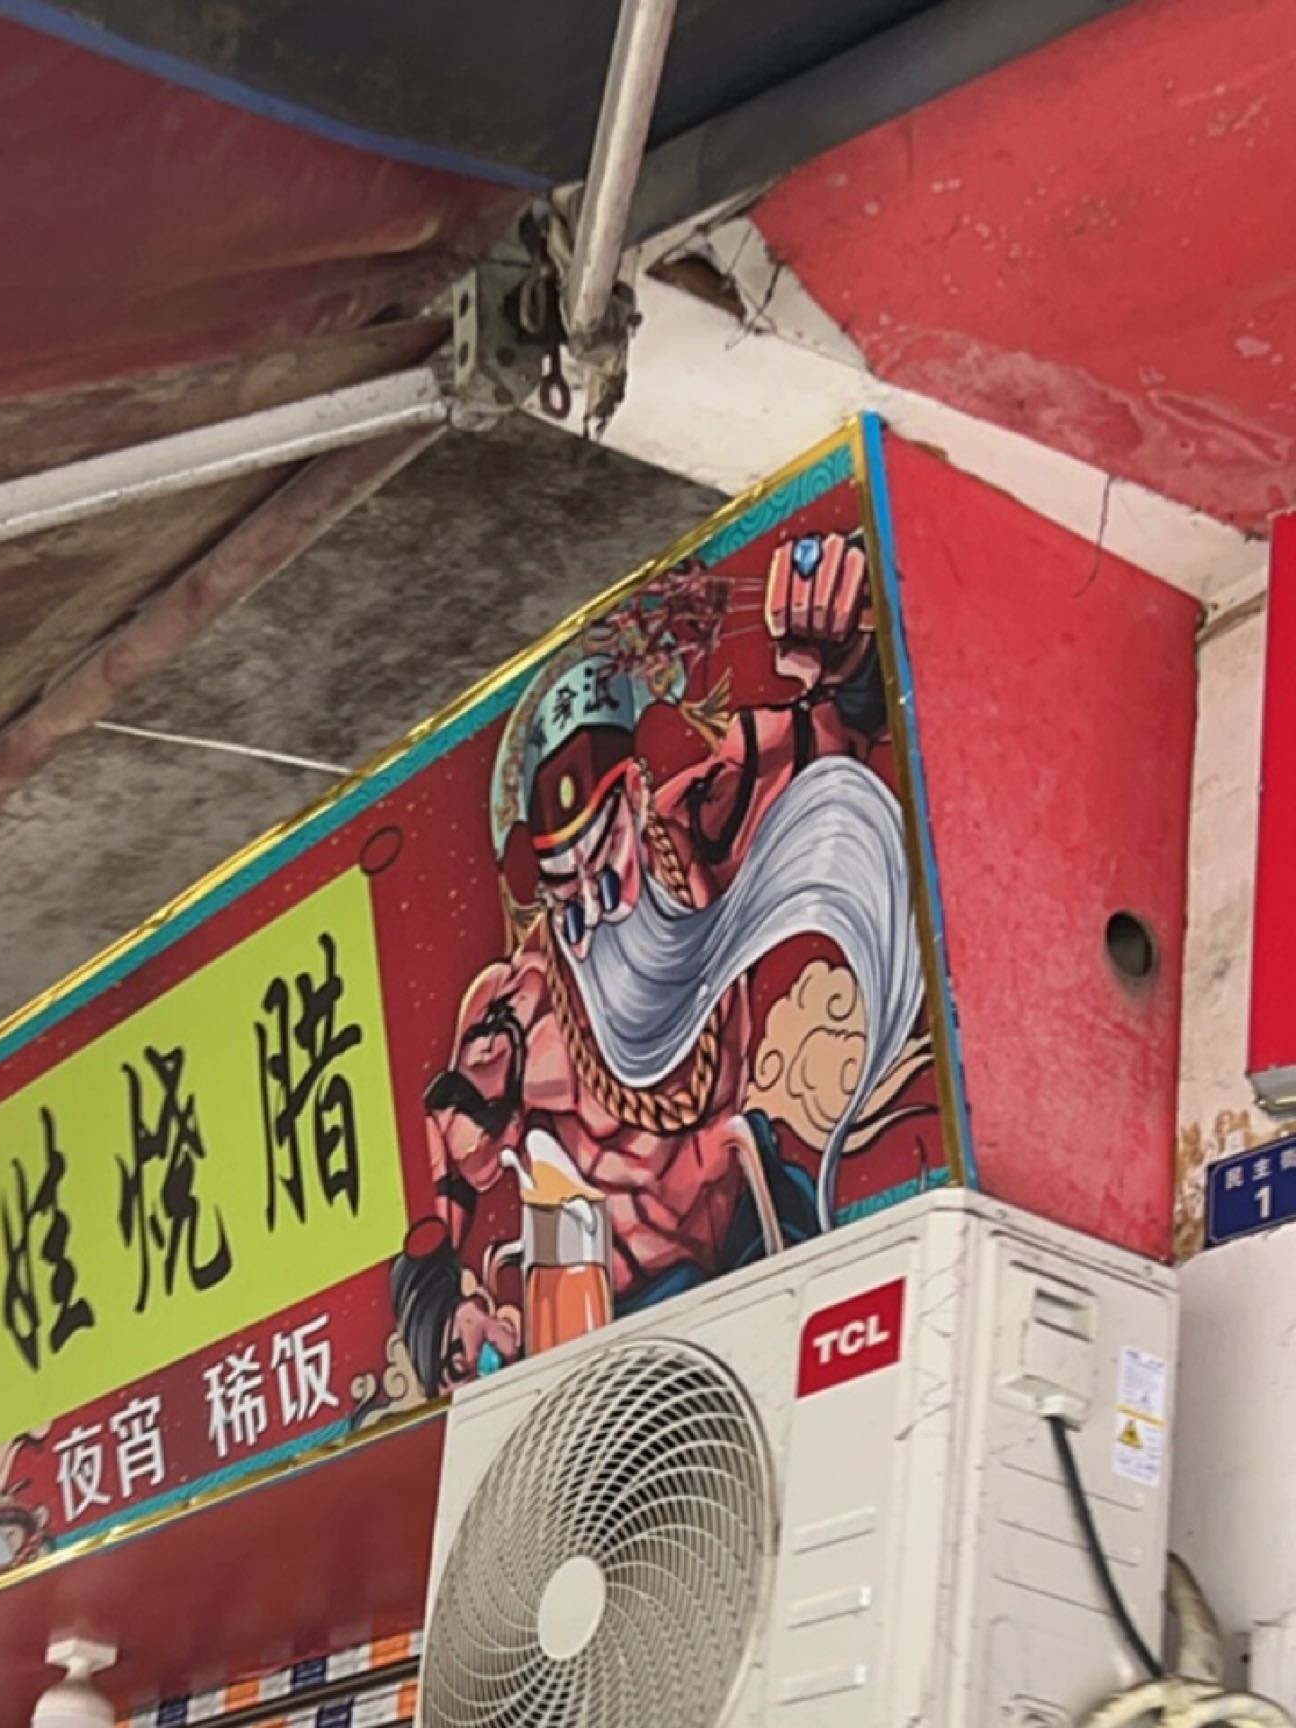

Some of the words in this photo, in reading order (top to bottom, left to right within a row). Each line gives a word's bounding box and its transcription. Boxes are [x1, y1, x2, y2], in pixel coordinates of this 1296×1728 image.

[812, 1314, 891, 1364] TCL
[52, 1395, 166, 1522] 夜宵
[202, 1312, 340, 1458] 稀饭
